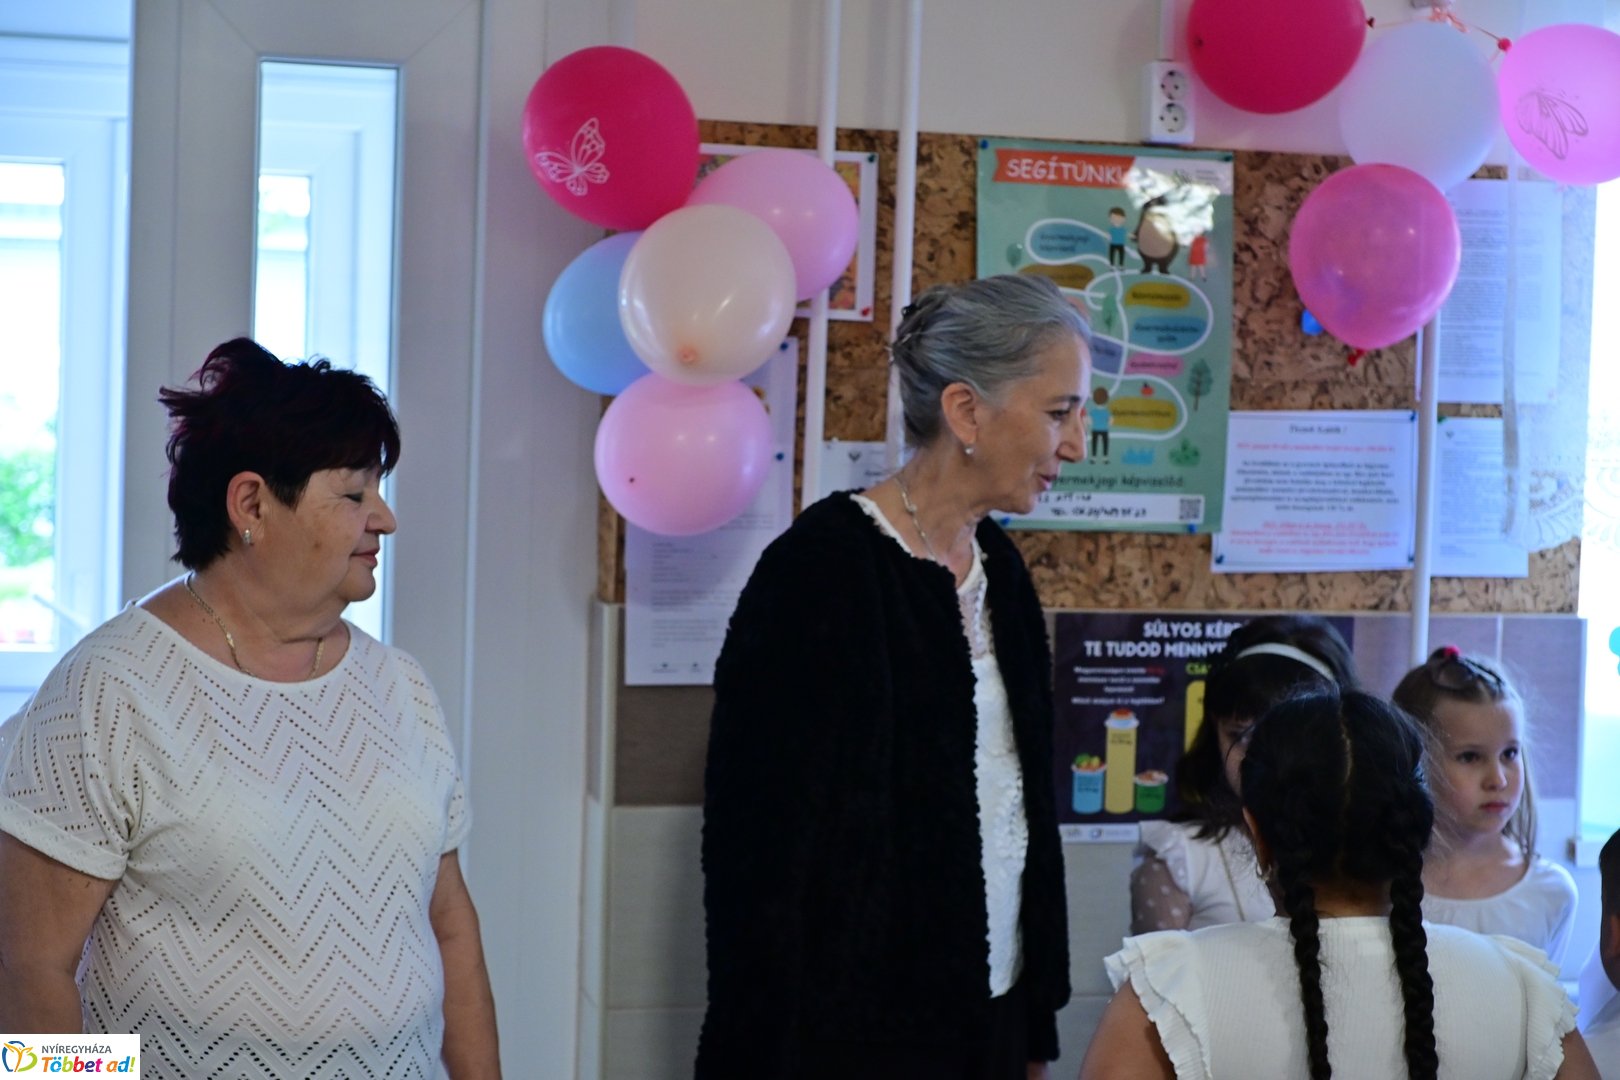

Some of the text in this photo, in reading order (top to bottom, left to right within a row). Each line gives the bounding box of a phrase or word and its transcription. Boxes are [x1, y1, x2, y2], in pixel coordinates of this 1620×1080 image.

[1143, 618, 1202, 638] SÚLYOS
[1084, 641, 1103, 657] TE
[1106, 641, 1161, 658] TUDOD
[1185, 663, 1212, 675] CSA
